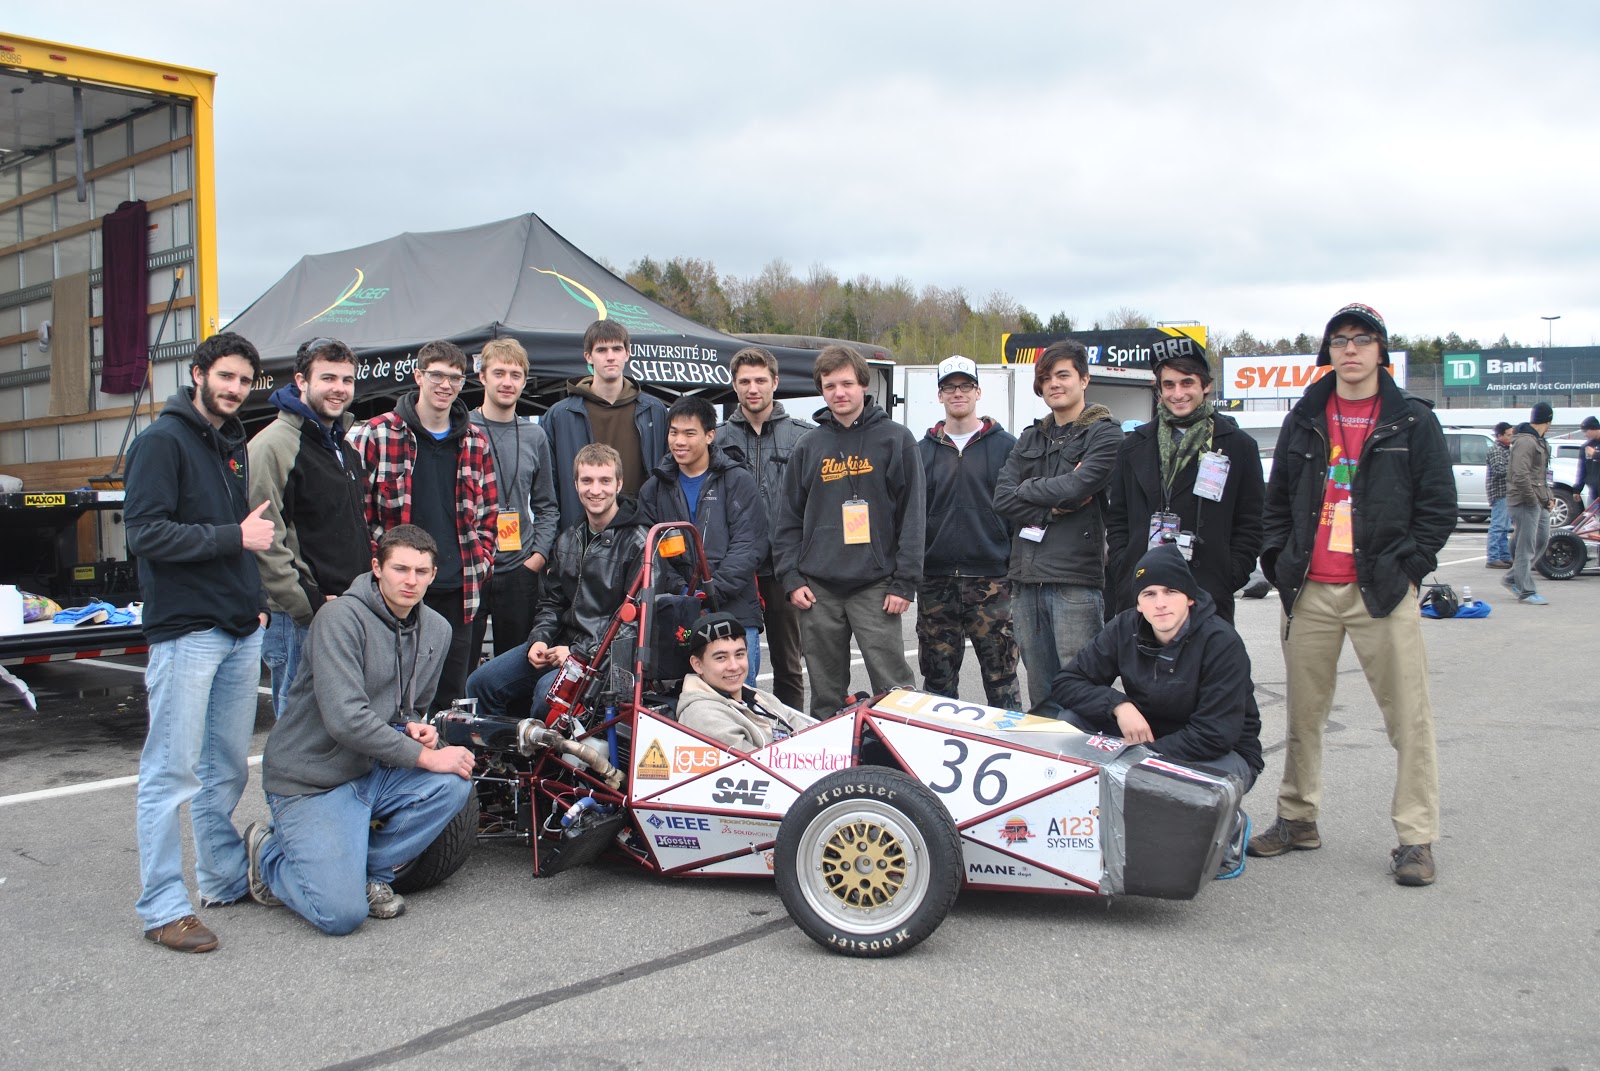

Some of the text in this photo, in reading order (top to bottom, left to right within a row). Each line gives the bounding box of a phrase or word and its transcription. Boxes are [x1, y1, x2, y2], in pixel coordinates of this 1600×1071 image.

[629, 343, 717, 361] UNIVERSITÉ DE
[1107, 344, 1151, 366] Sprin
[1152, 338, 1193, 361] BRO
[354, 353, 419, 382] té de gén
[629, 360, 732, 385] SHERBRO
[1234, 366, 1334, 390] SYLVA
[1447, 357, 1543, 380] TD Bank
[1486, 380, 1600, 391] America's Most Convenien
[821, 455, 873, 475] Huskies
[26, 495, 63, 504] MAXON
[499, 520, 519, 540] DAP
[697, 621, 732, 643] YO
[675, 746, 718, 773] igus
[768, 745, 851, 771] Rensselaer
[928, 738, 1012, 806] 36
[712, 777, 770, 806] SAE
[816, 783, 898, 806] Hoosier
[665, 816, 711, 831] IEEE
[733, 829, 773, 838] SOLIDWORKS
[1047, 816, 1094, 837] A123
[1047, 838, 1095, 849] SYSTEMS
[969, 863, 1016, 876] MANE
[828, 928, 911, 951] Hoosier
